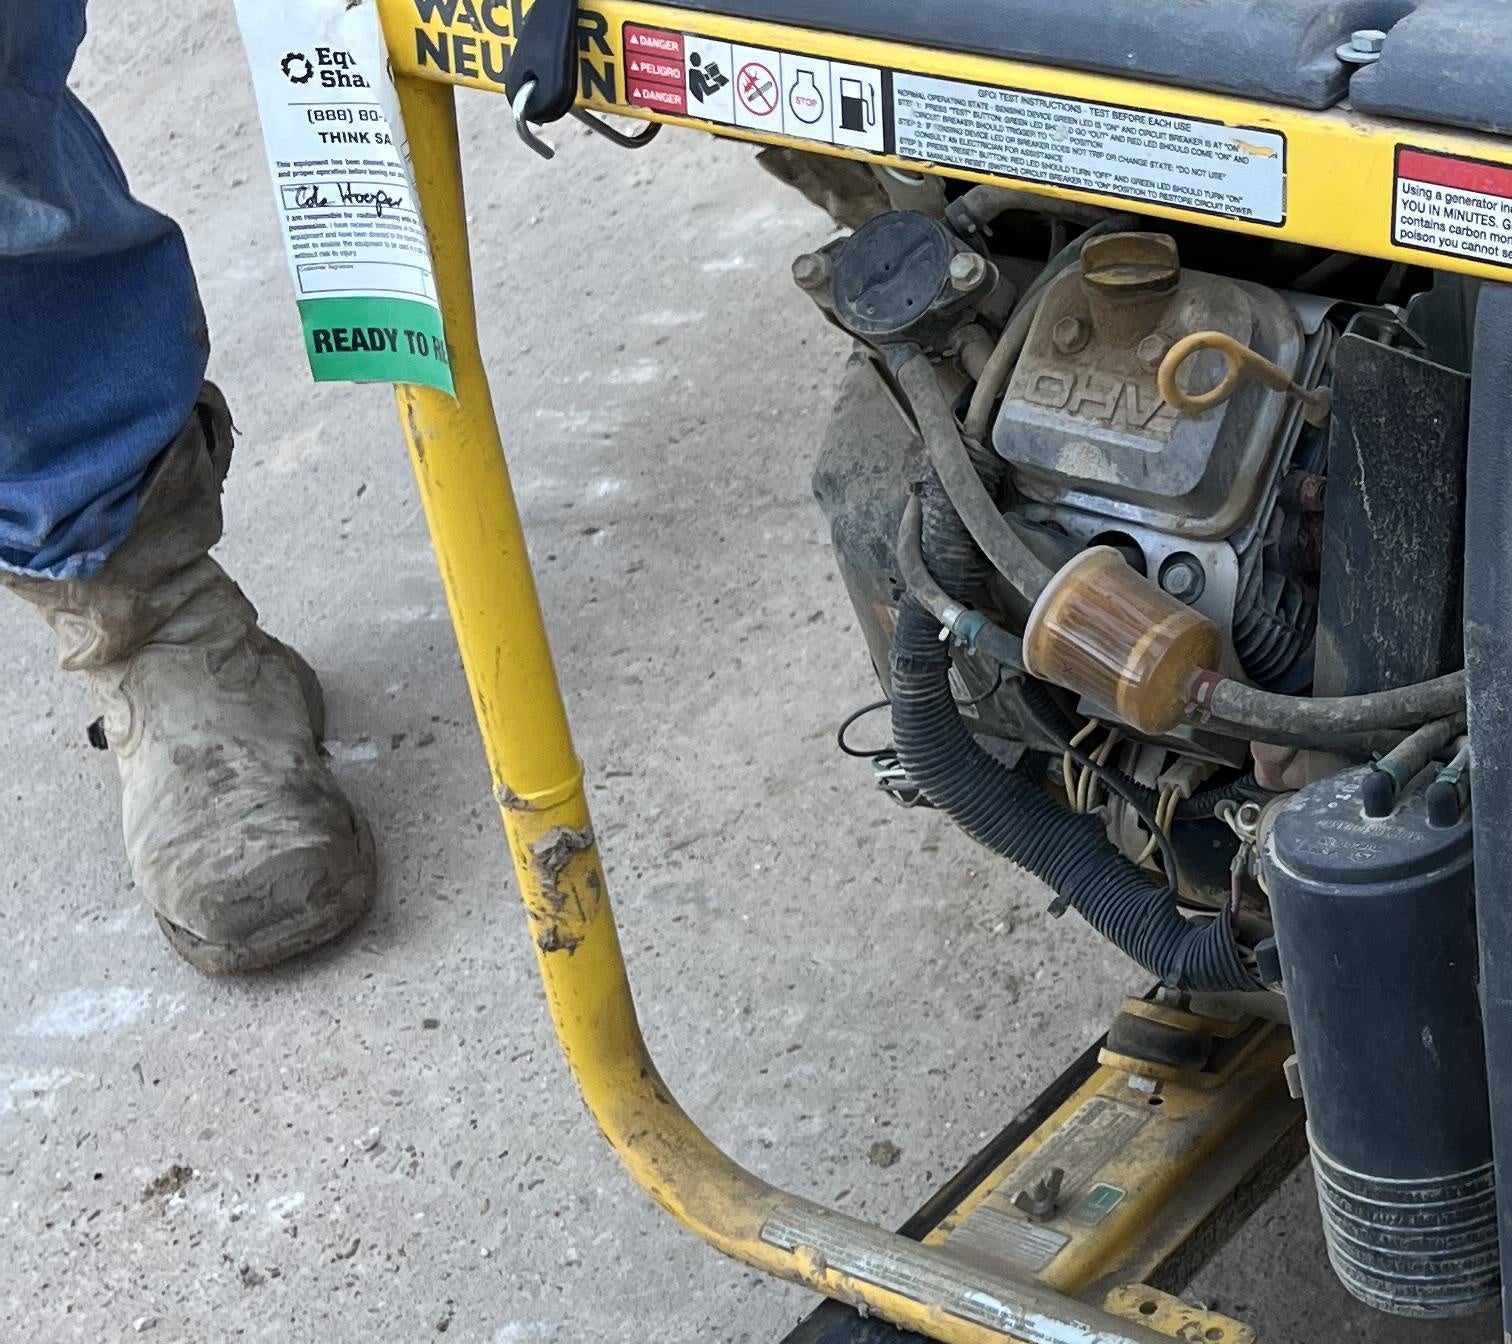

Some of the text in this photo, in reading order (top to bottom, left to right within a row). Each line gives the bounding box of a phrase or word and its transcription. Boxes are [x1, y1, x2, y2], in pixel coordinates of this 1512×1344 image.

[640, 33, 679, 53] DANGER
[415, 28, 617, 104] NEUN
[640, 60, 681, 79] PELIGRO
[642, 88, 682, 106] DANGER
[795, 95, 817, 108] STOP
[318, 131, 371, 144] THINK
[1401, 182, 1432, 201] Using
[1435, 191, 1442, 200] a
[1445, 191, 1497, 213] generator
[1401, 198, 1425, 214] YOU
[1429, 204, 1440, 217] IN
[1443, 206, 1499, 228] MINUTES.
[1400, 214, 1445, 232] contains
[1448, 223, 1486, 240] carbon
[1399, 228, 1435, 245] poison
[1438, 237, 1457, 250] you
[1461, 239, 1498, 256] cannot
[312, 327, 398, 353] READY
[404, 329, 429, 356] TO
[1022, 369, 1179, 428] OHV
